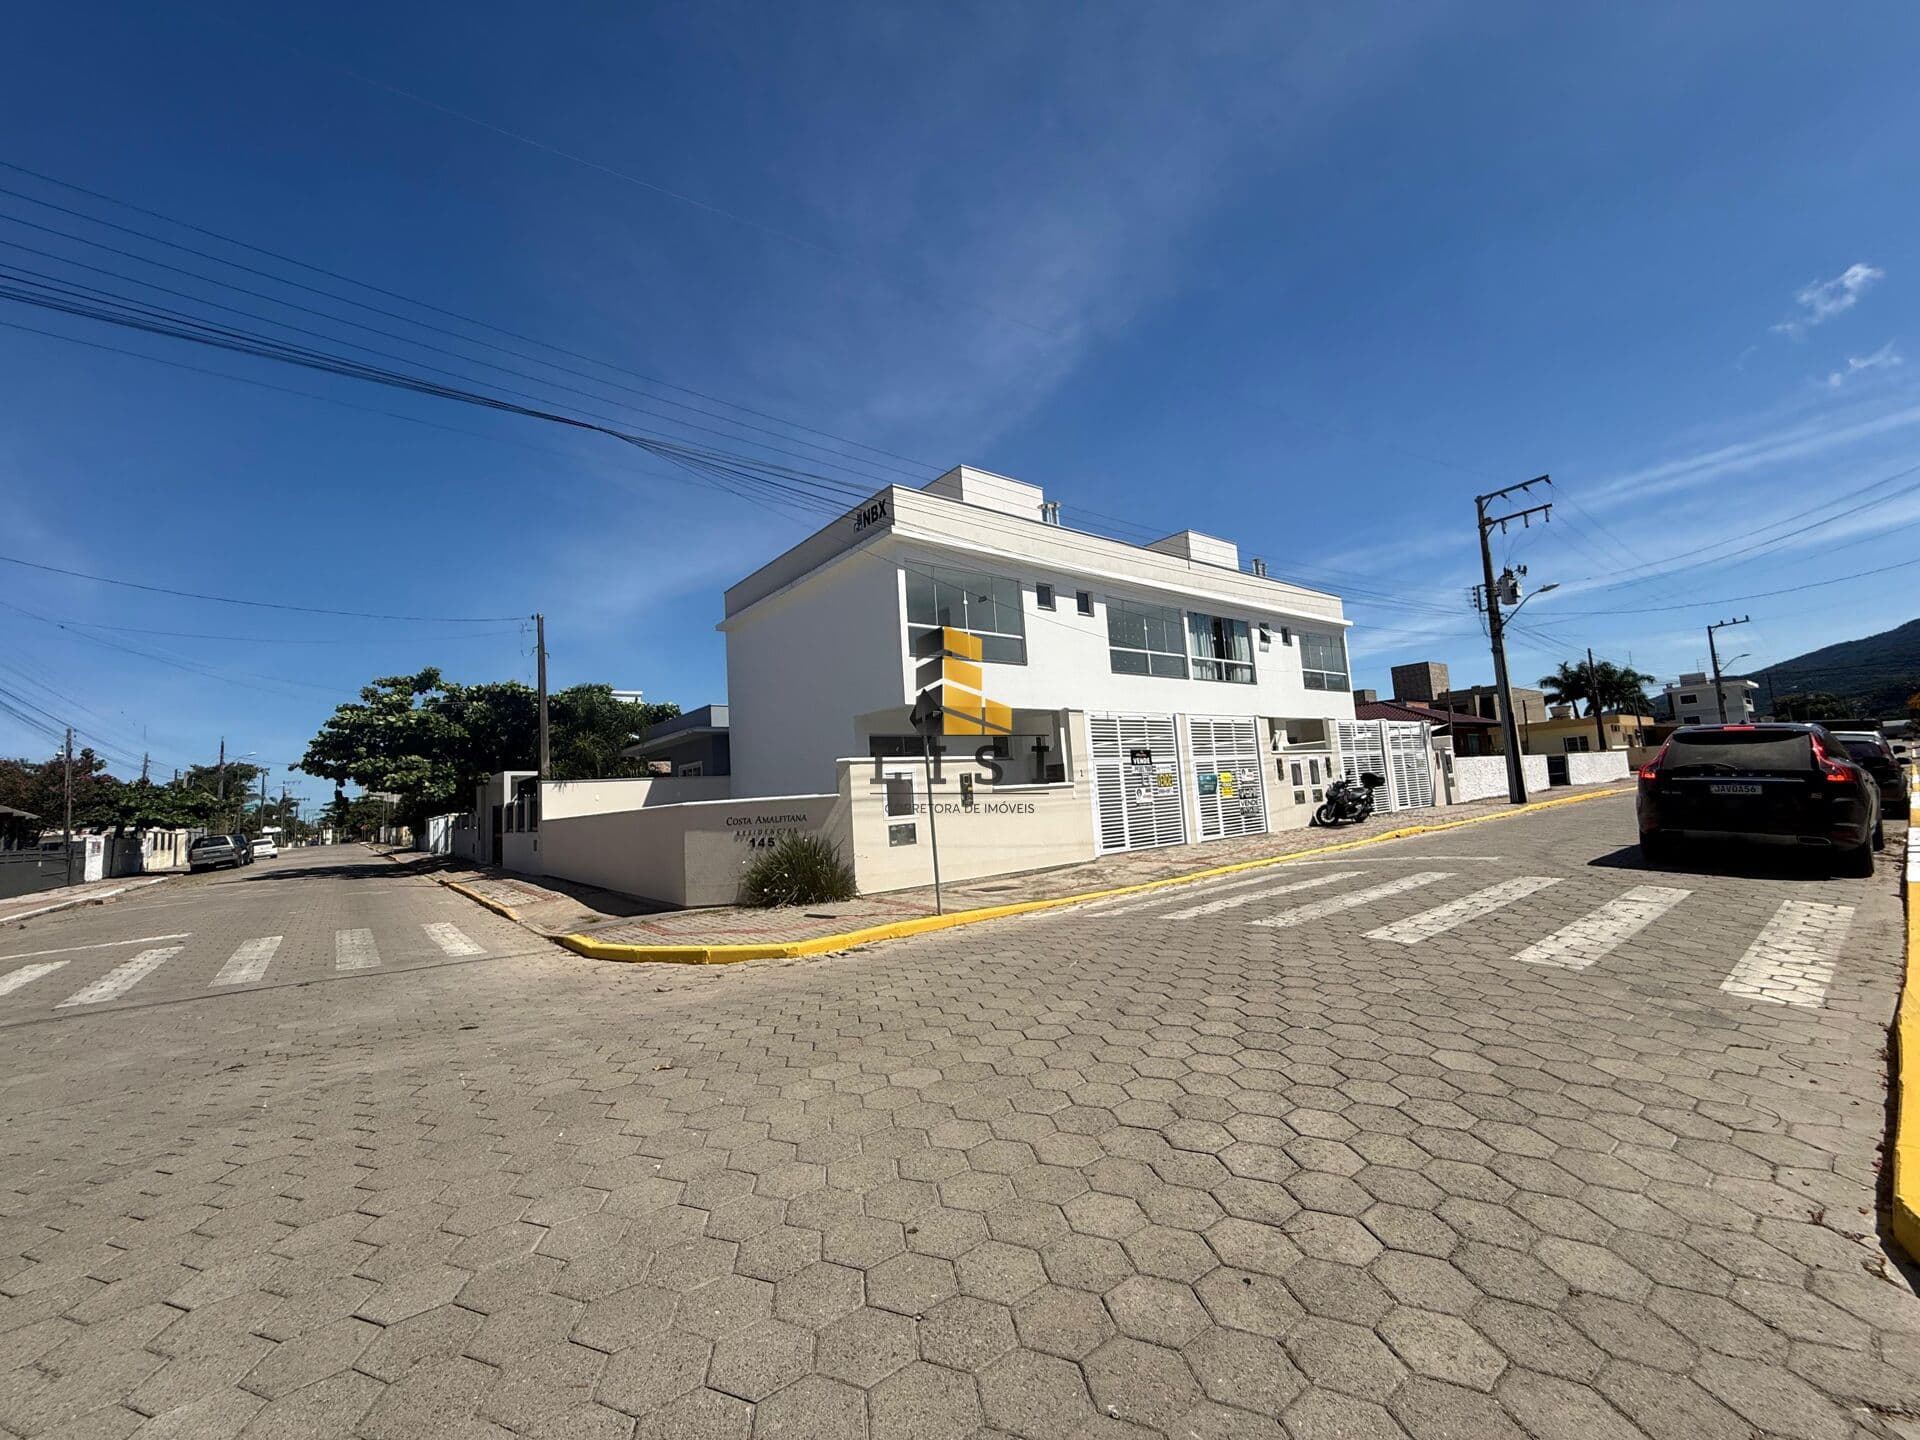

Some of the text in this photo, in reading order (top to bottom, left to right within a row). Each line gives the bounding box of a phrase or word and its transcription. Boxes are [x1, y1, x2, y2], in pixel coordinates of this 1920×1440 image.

[863, 498, 887, 528] NBX
[726, 814, 807, 826] COSTA AMALFITANA
[749, 837, 775, 848] 145
